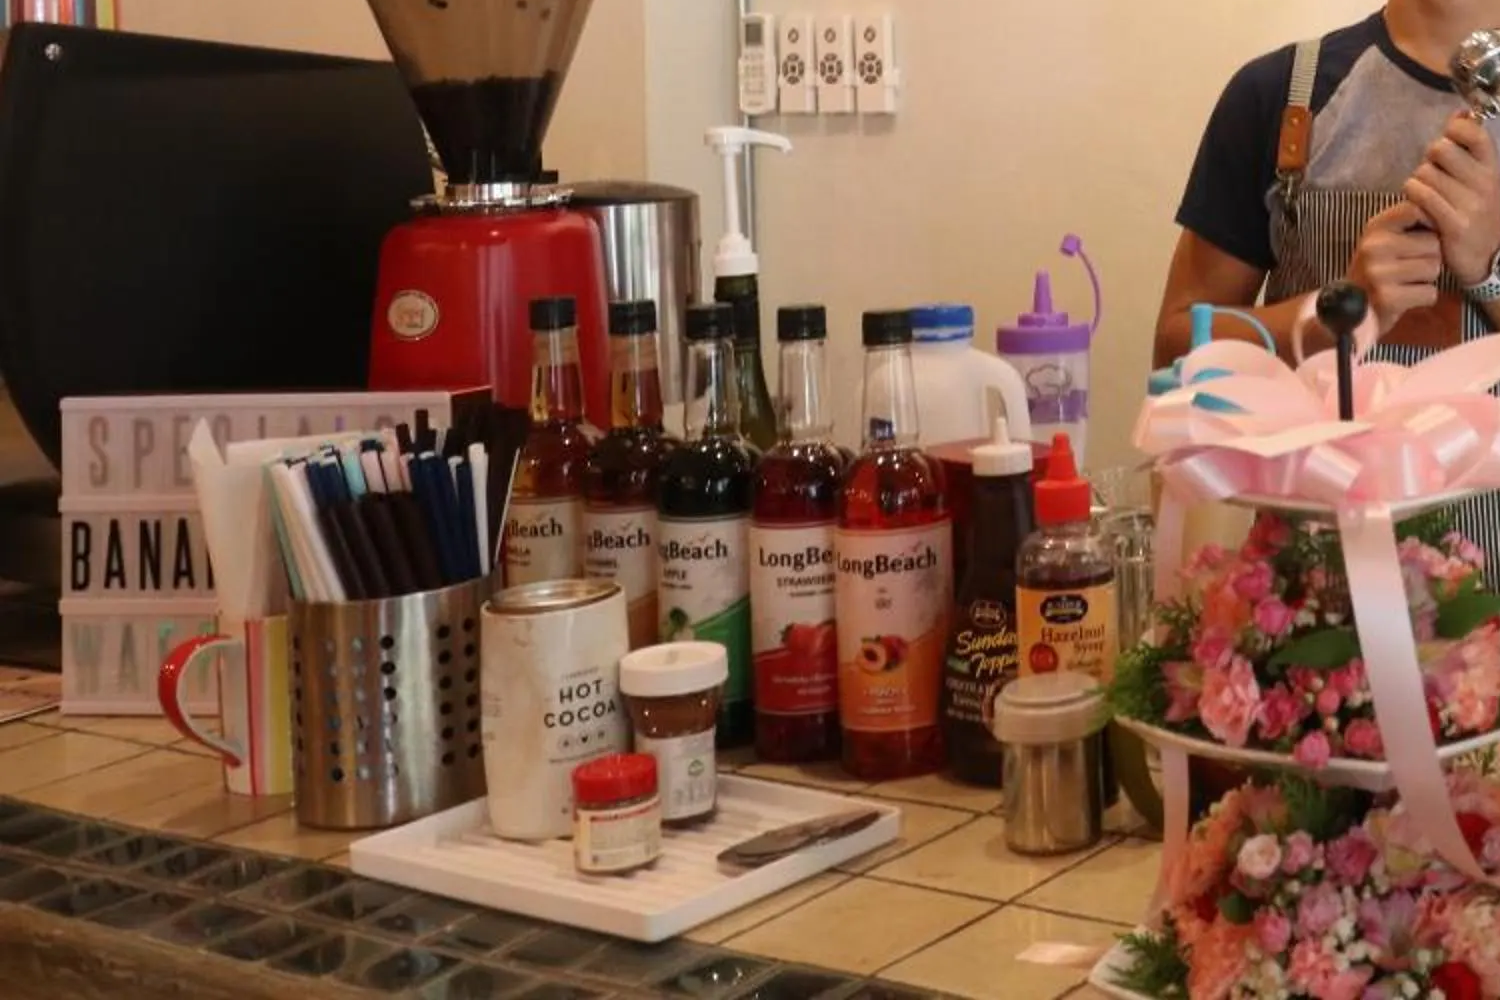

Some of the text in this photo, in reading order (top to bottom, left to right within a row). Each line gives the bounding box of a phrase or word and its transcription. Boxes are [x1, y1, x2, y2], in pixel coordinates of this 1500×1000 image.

[71, 518, 216, 591] BANA
[836, 545, 937, 580] LongBeach
[559, 679, 603, 705] HOT
[543, 698, 617, 729] COCOA
